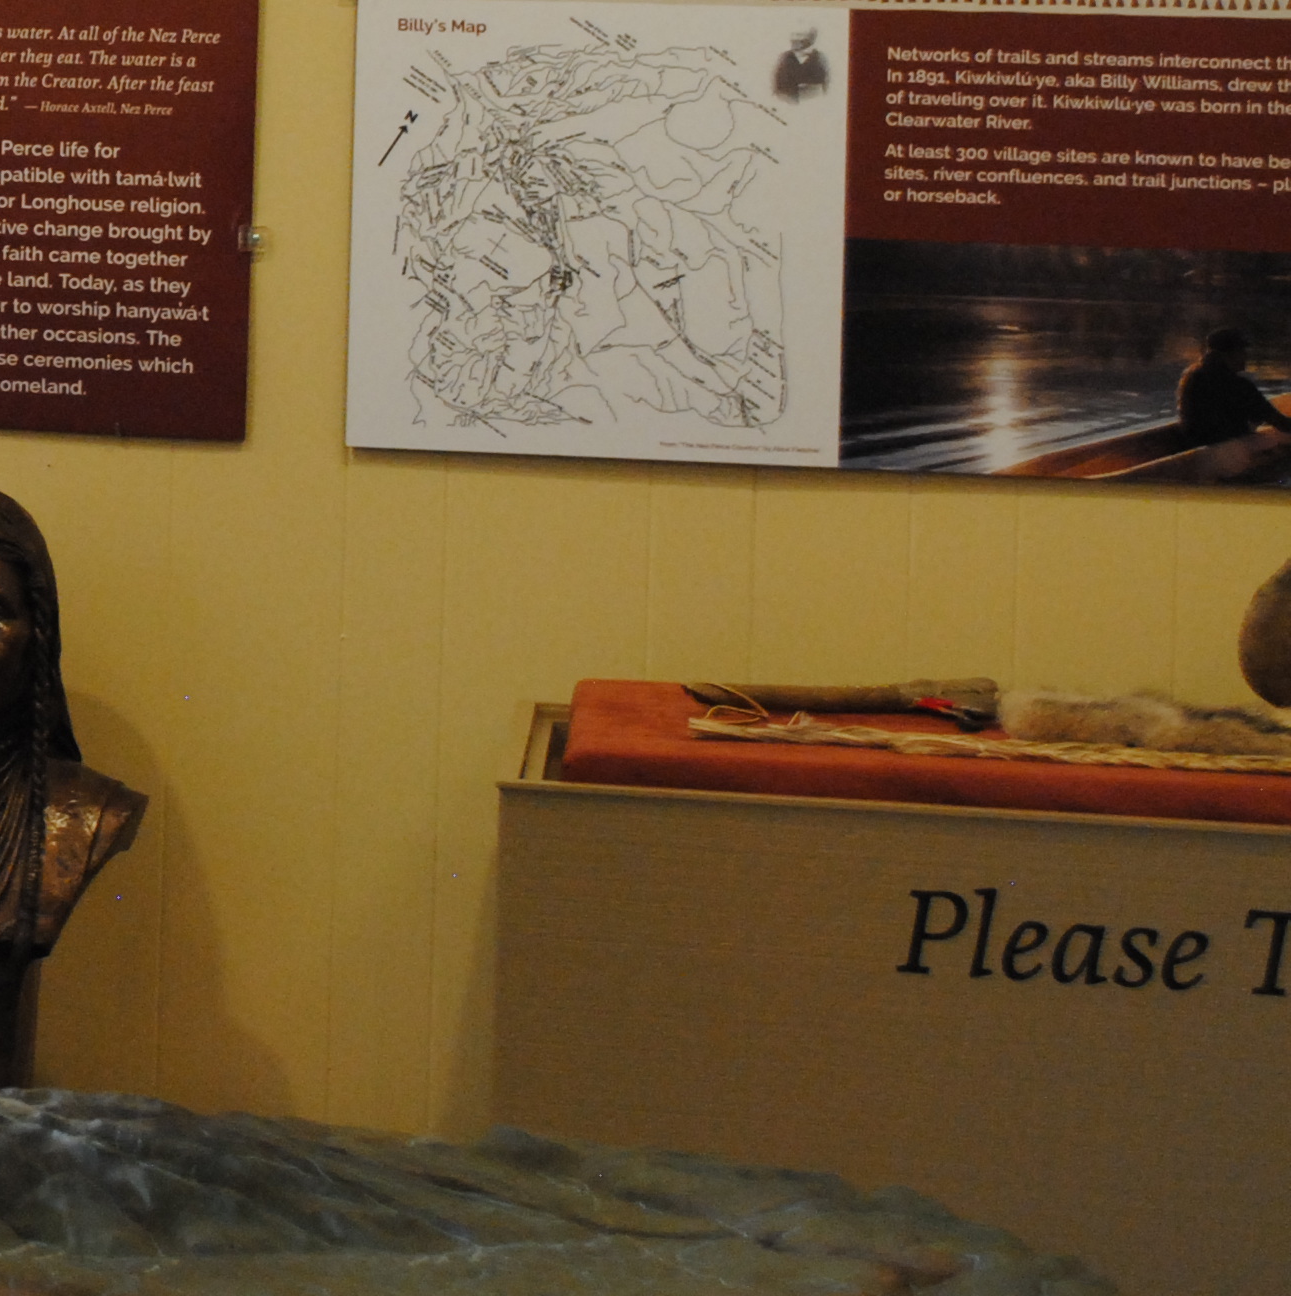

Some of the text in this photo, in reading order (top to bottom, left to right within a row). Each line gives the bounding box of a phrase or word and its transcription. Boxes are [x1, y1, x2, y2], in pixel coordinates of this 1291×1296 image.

[397, 18, 487, 36] Billy's Map
[404, 109, 419, 124] N
[884, 111, 1033, 131] Clearwater River.
[0, 139, 55, 158] Perce
[59, 140, 90, 159] life
[93, 141, 122, 159] for
[883, 188, 1002, 205] or horseback.
[896, 888, 1291, 997] Please T
